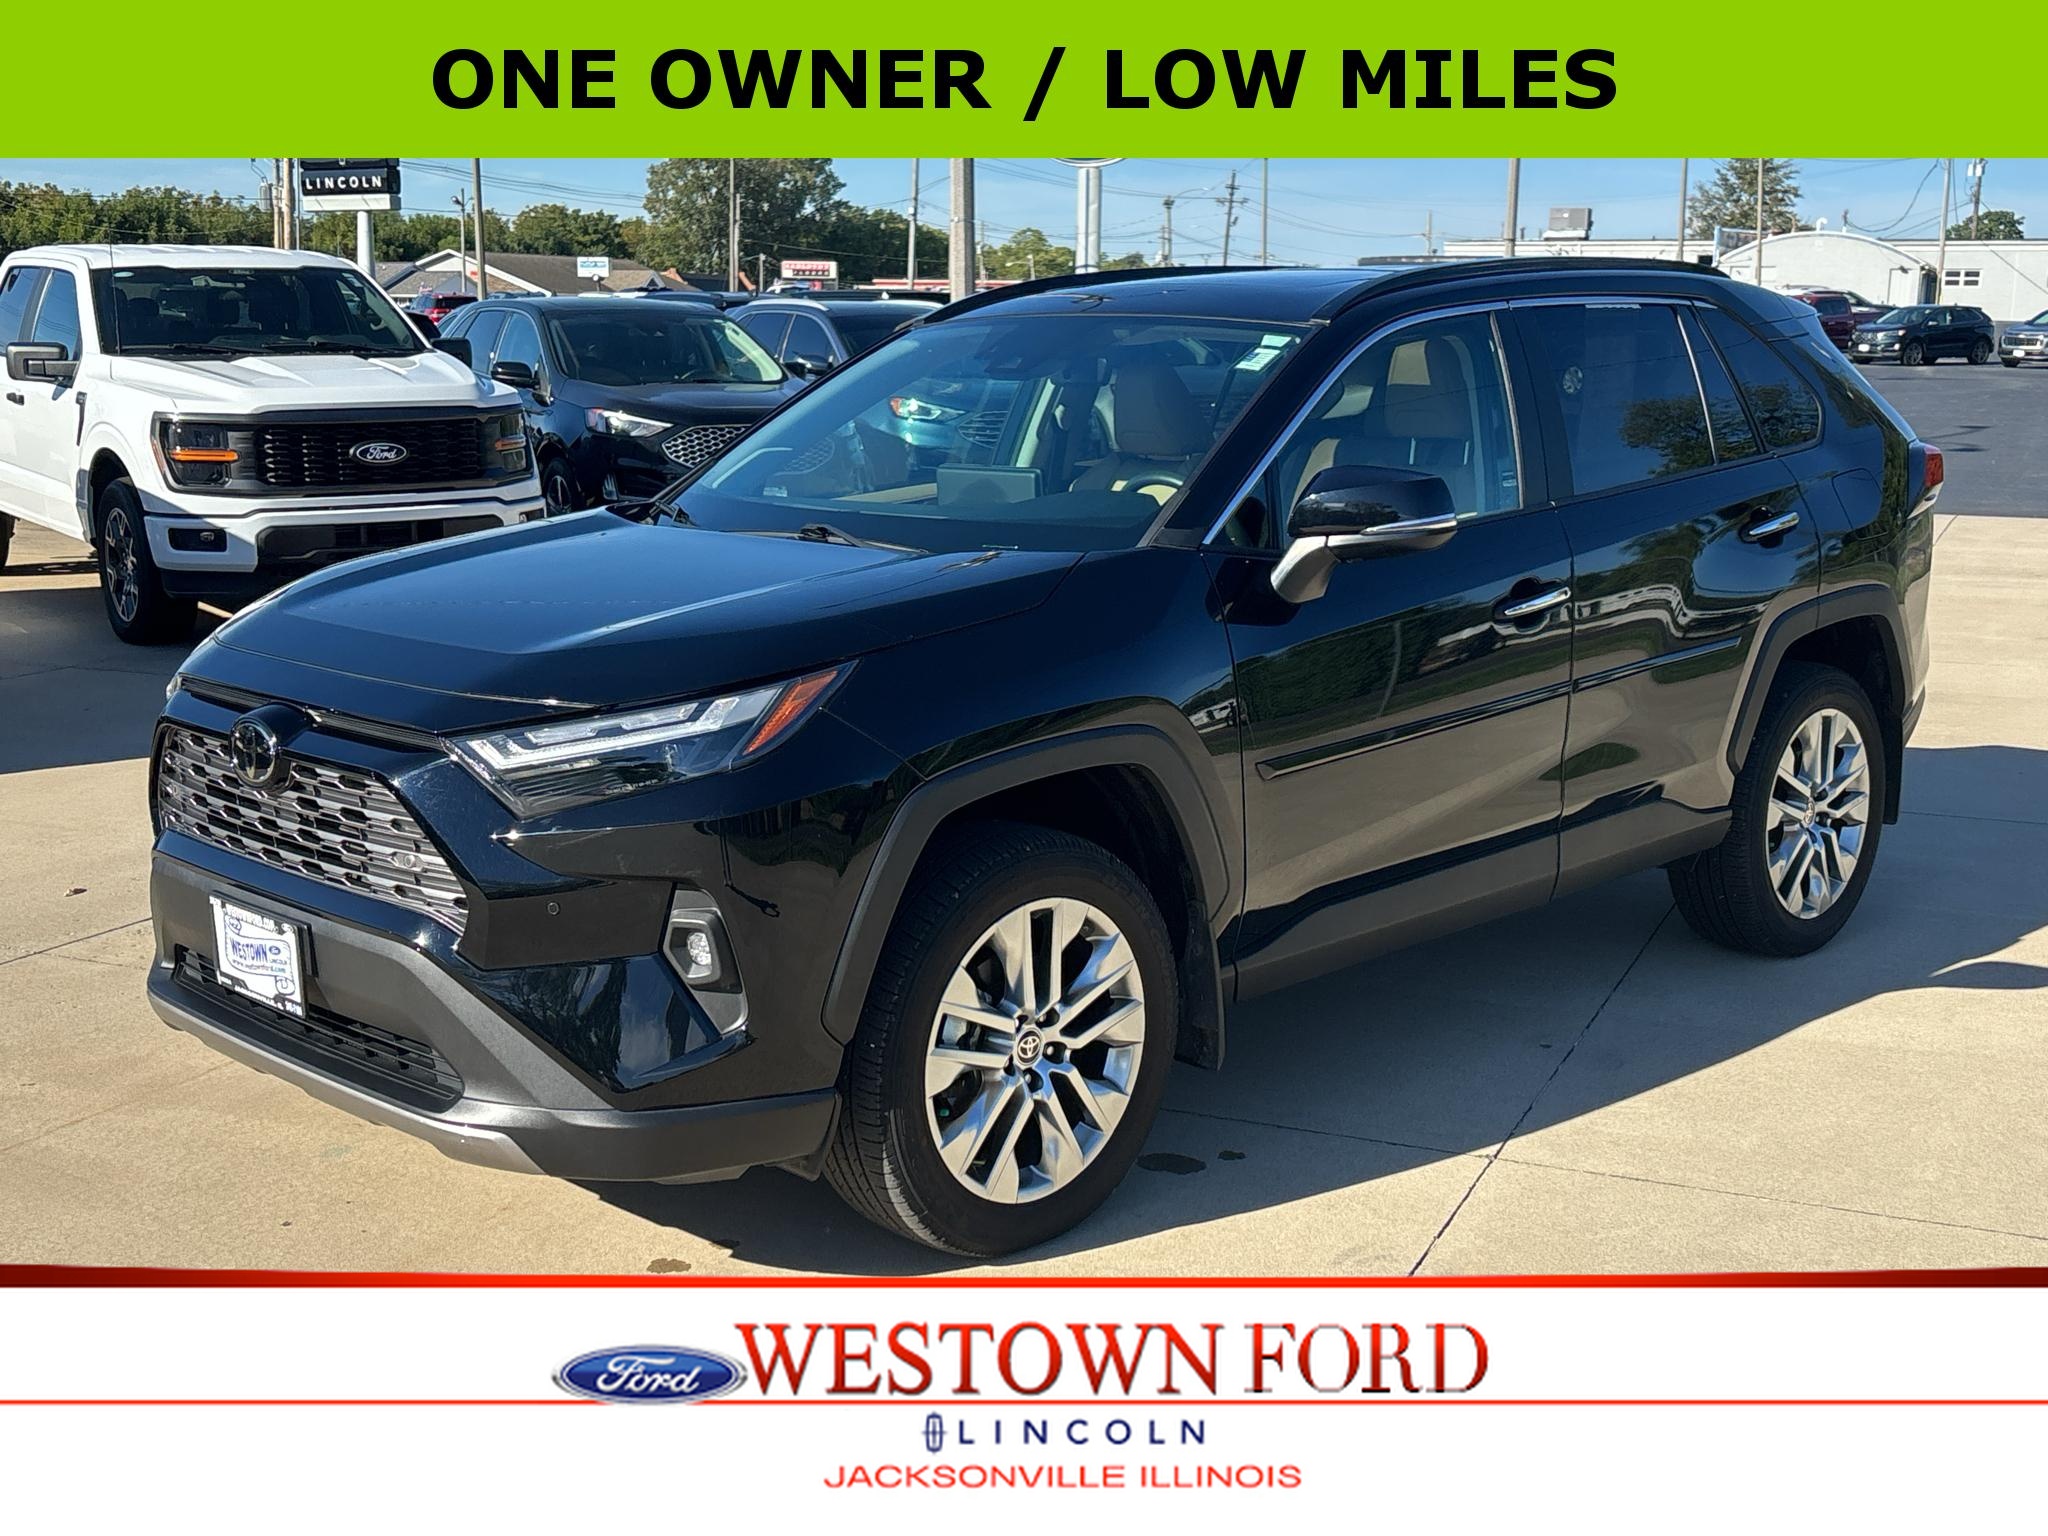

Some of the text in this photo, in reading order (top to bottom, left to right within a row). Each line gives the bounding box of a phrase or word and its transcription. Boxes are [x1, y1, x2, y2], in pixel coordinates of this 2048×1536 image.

[304, 175, 382, 190] LINCOLN
[366, 445, 397, 460] Ford
[230, 937, 268, 963] WESTOWN
